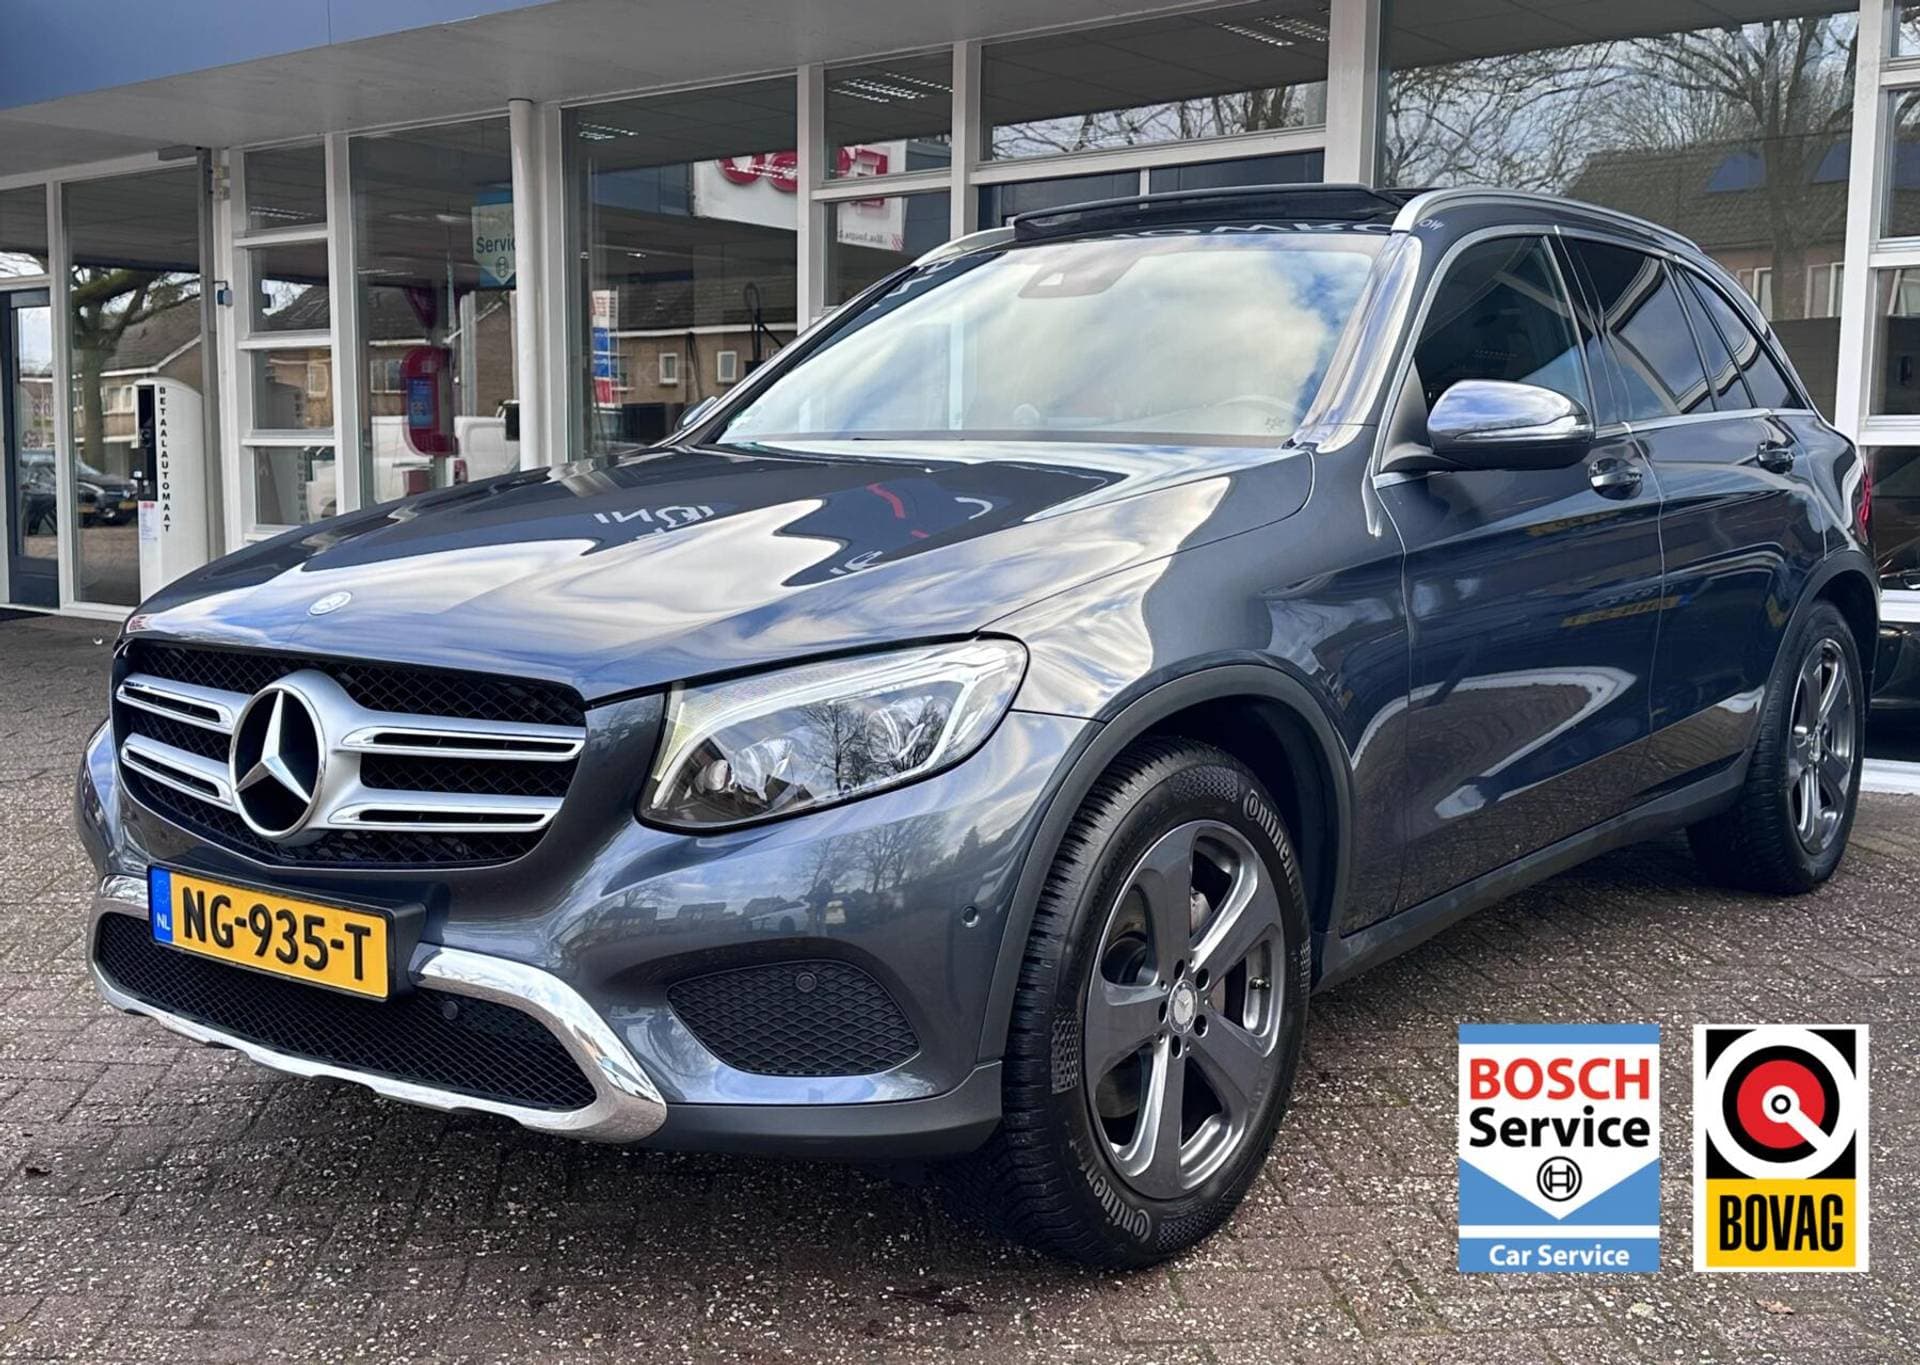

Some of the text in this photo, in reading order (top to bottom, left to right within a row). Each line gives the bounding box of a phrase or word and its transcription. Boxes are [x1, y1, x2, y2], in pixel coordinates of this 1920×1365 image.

[159, 386, 171, 532] BETAALAUTOMAAT
[157, 913, 171, 931] NL
[182, 886, 371, 981] NG-935-T
